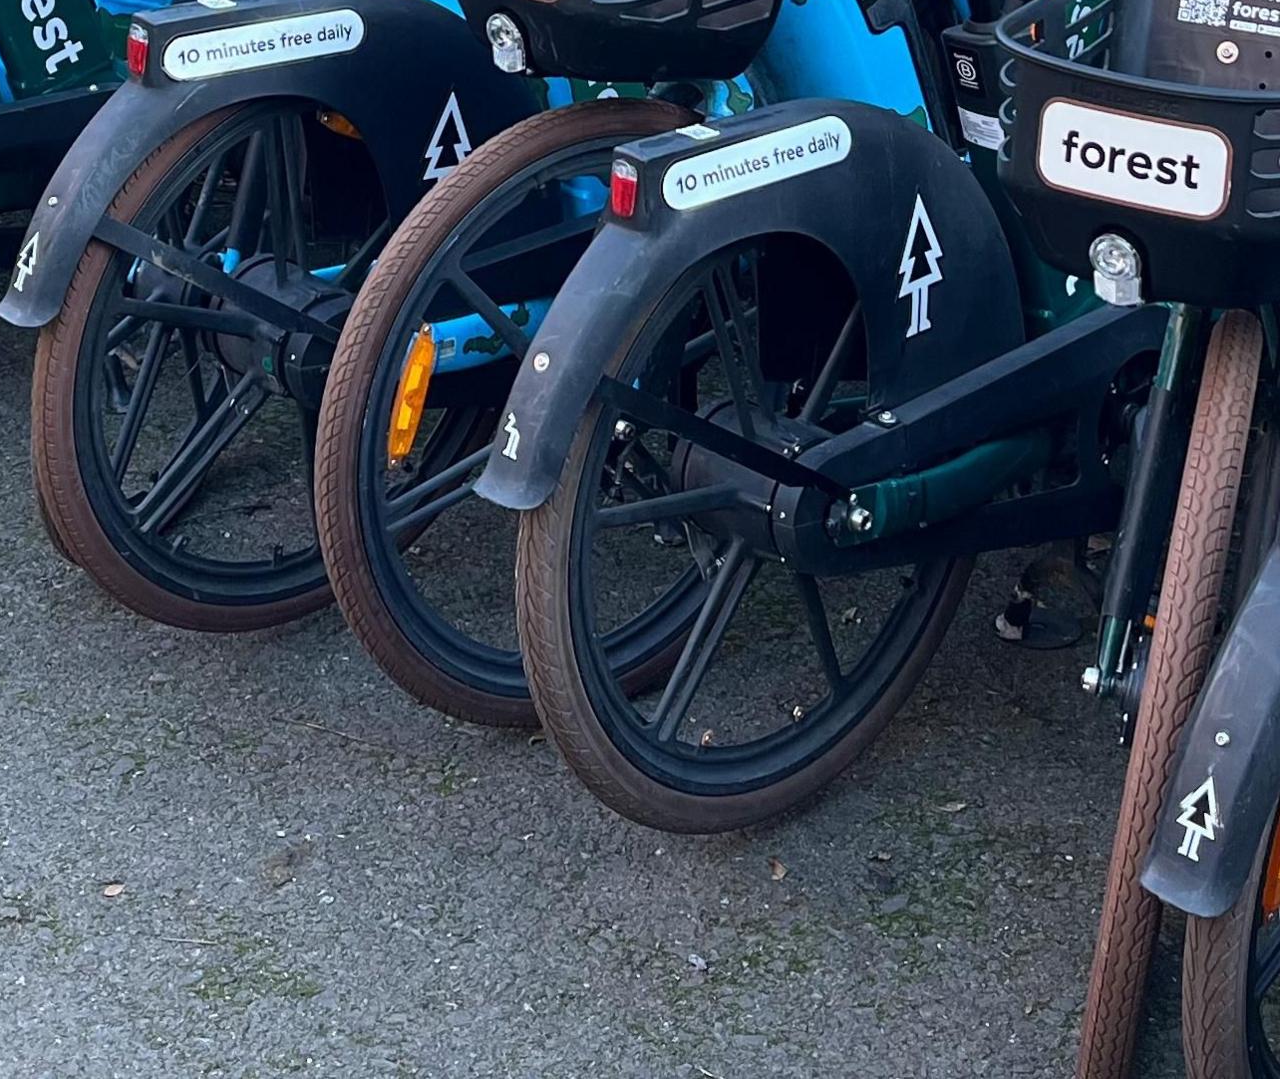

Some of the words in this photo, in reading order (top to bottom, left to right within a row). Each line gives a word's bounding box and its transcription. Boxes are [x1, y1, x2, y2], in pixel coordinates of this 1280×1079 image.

[177, 48, 200, 65] 10
[206, 36, 276, 61] minutes
[279, 31, 313, 49] free
[317, 23, 353, 42] daily
[676, 173, 698, 195] 10
[703, 154, 771, 188] minutes
[772, 144, 805, 166] free
[807, 131, 841, 154] daily
[1061, 129, 1201, 190] forest
